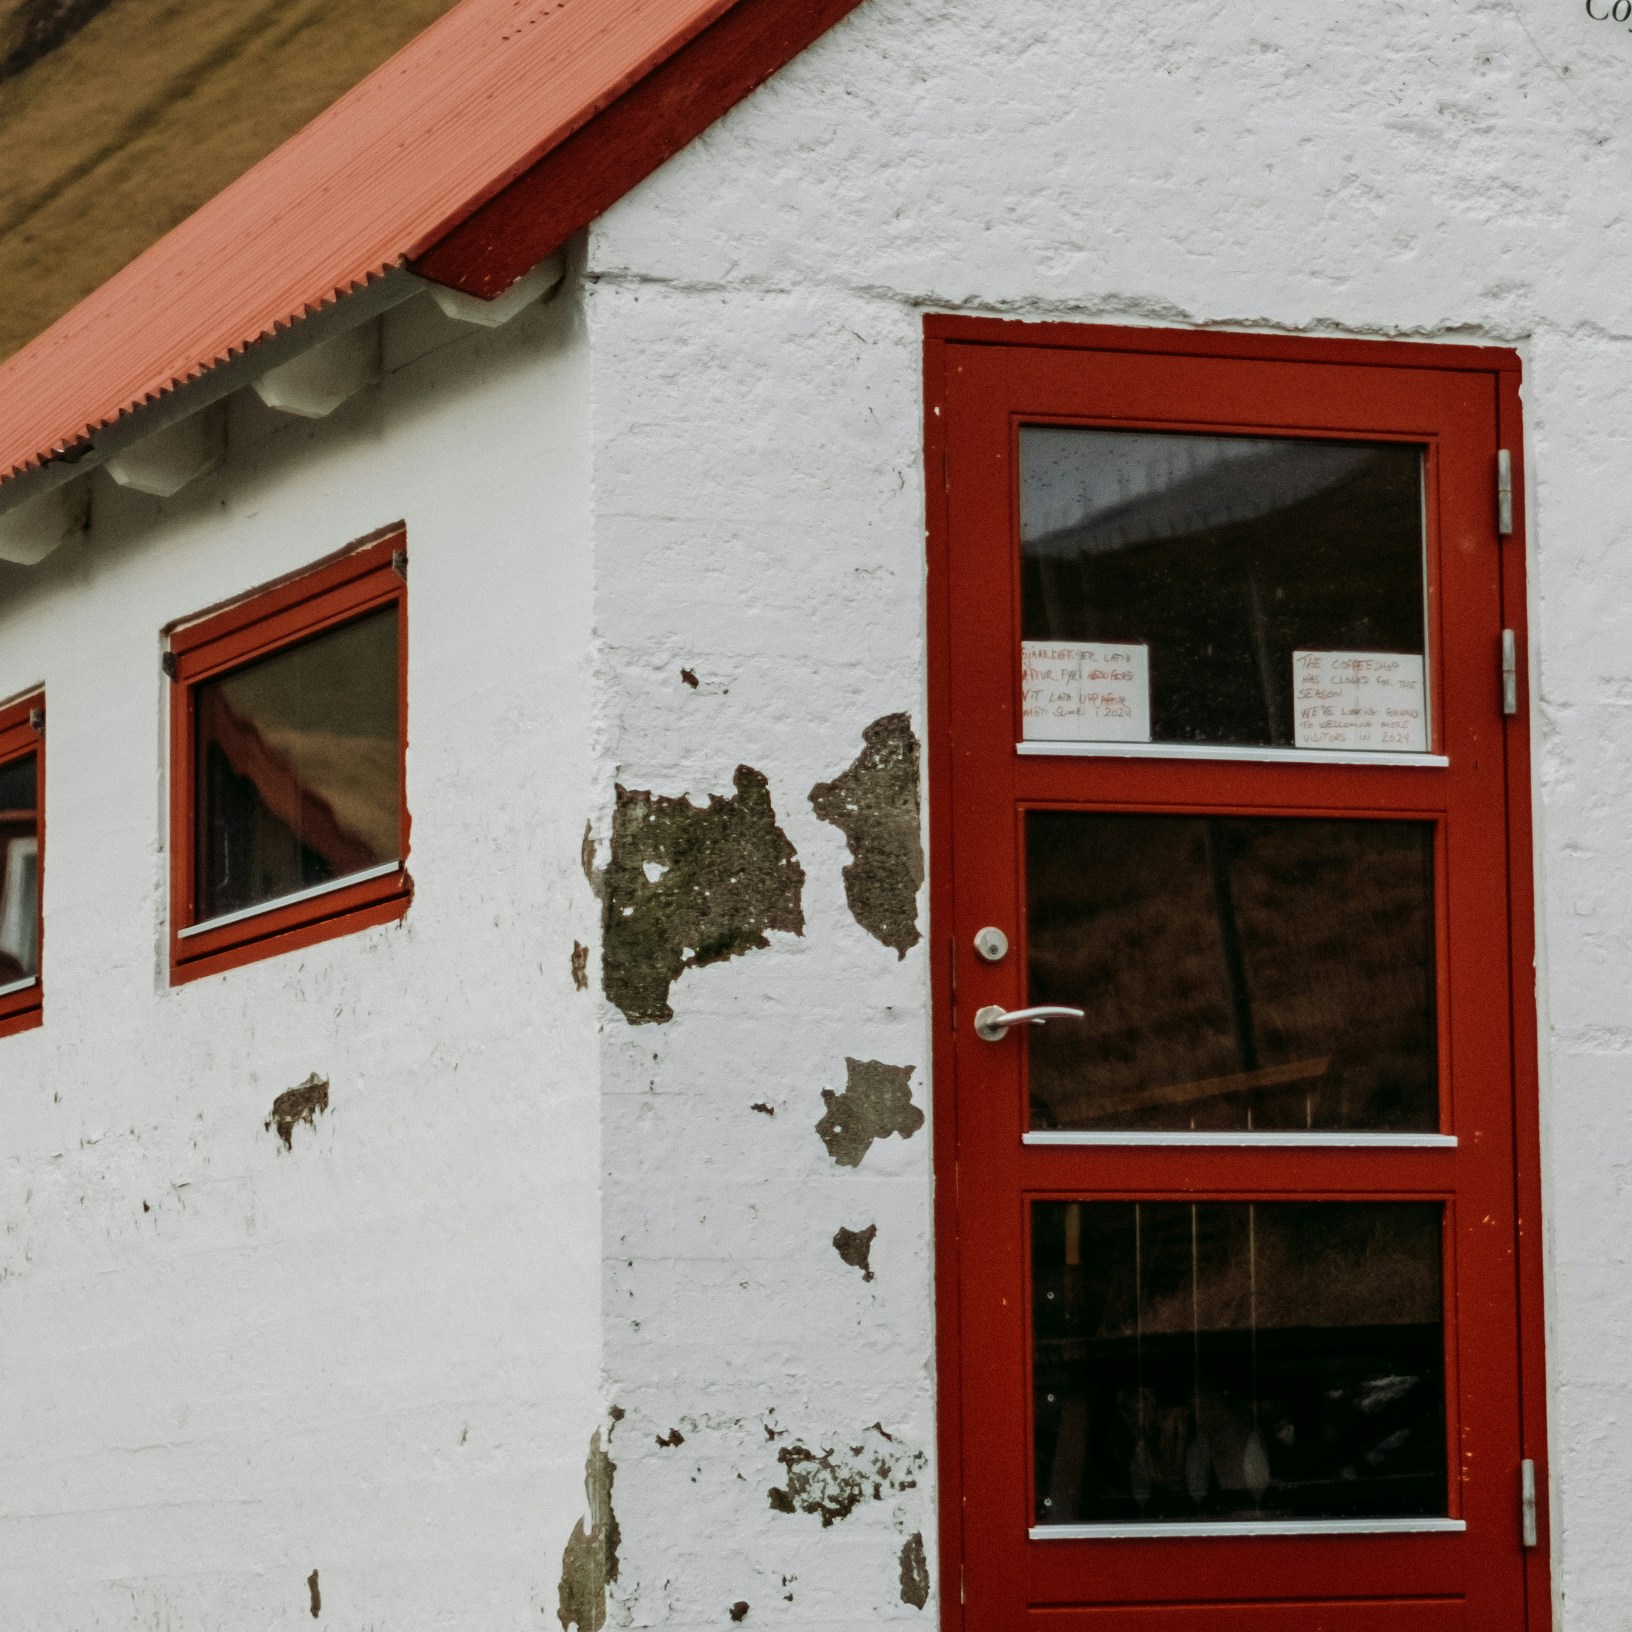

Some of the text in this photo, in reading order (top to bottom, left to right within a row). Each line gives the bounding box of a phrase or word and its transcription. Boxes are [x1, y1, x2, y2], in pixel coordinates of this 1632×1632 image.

[1296, 653, 1322, 669] THE
[1301, 674, 1320, 684] HAS
[1397, 679, 1418, 689] THE
[1296, 688, 1342, 699] SEASON
[1103, 707, 1132, 718] 2024
[1299, 720, 1313, 729] TO
[1381, 720, 1409, 729] MORE
[1304, 731, 1409, 744] VISITORS IN 2024
